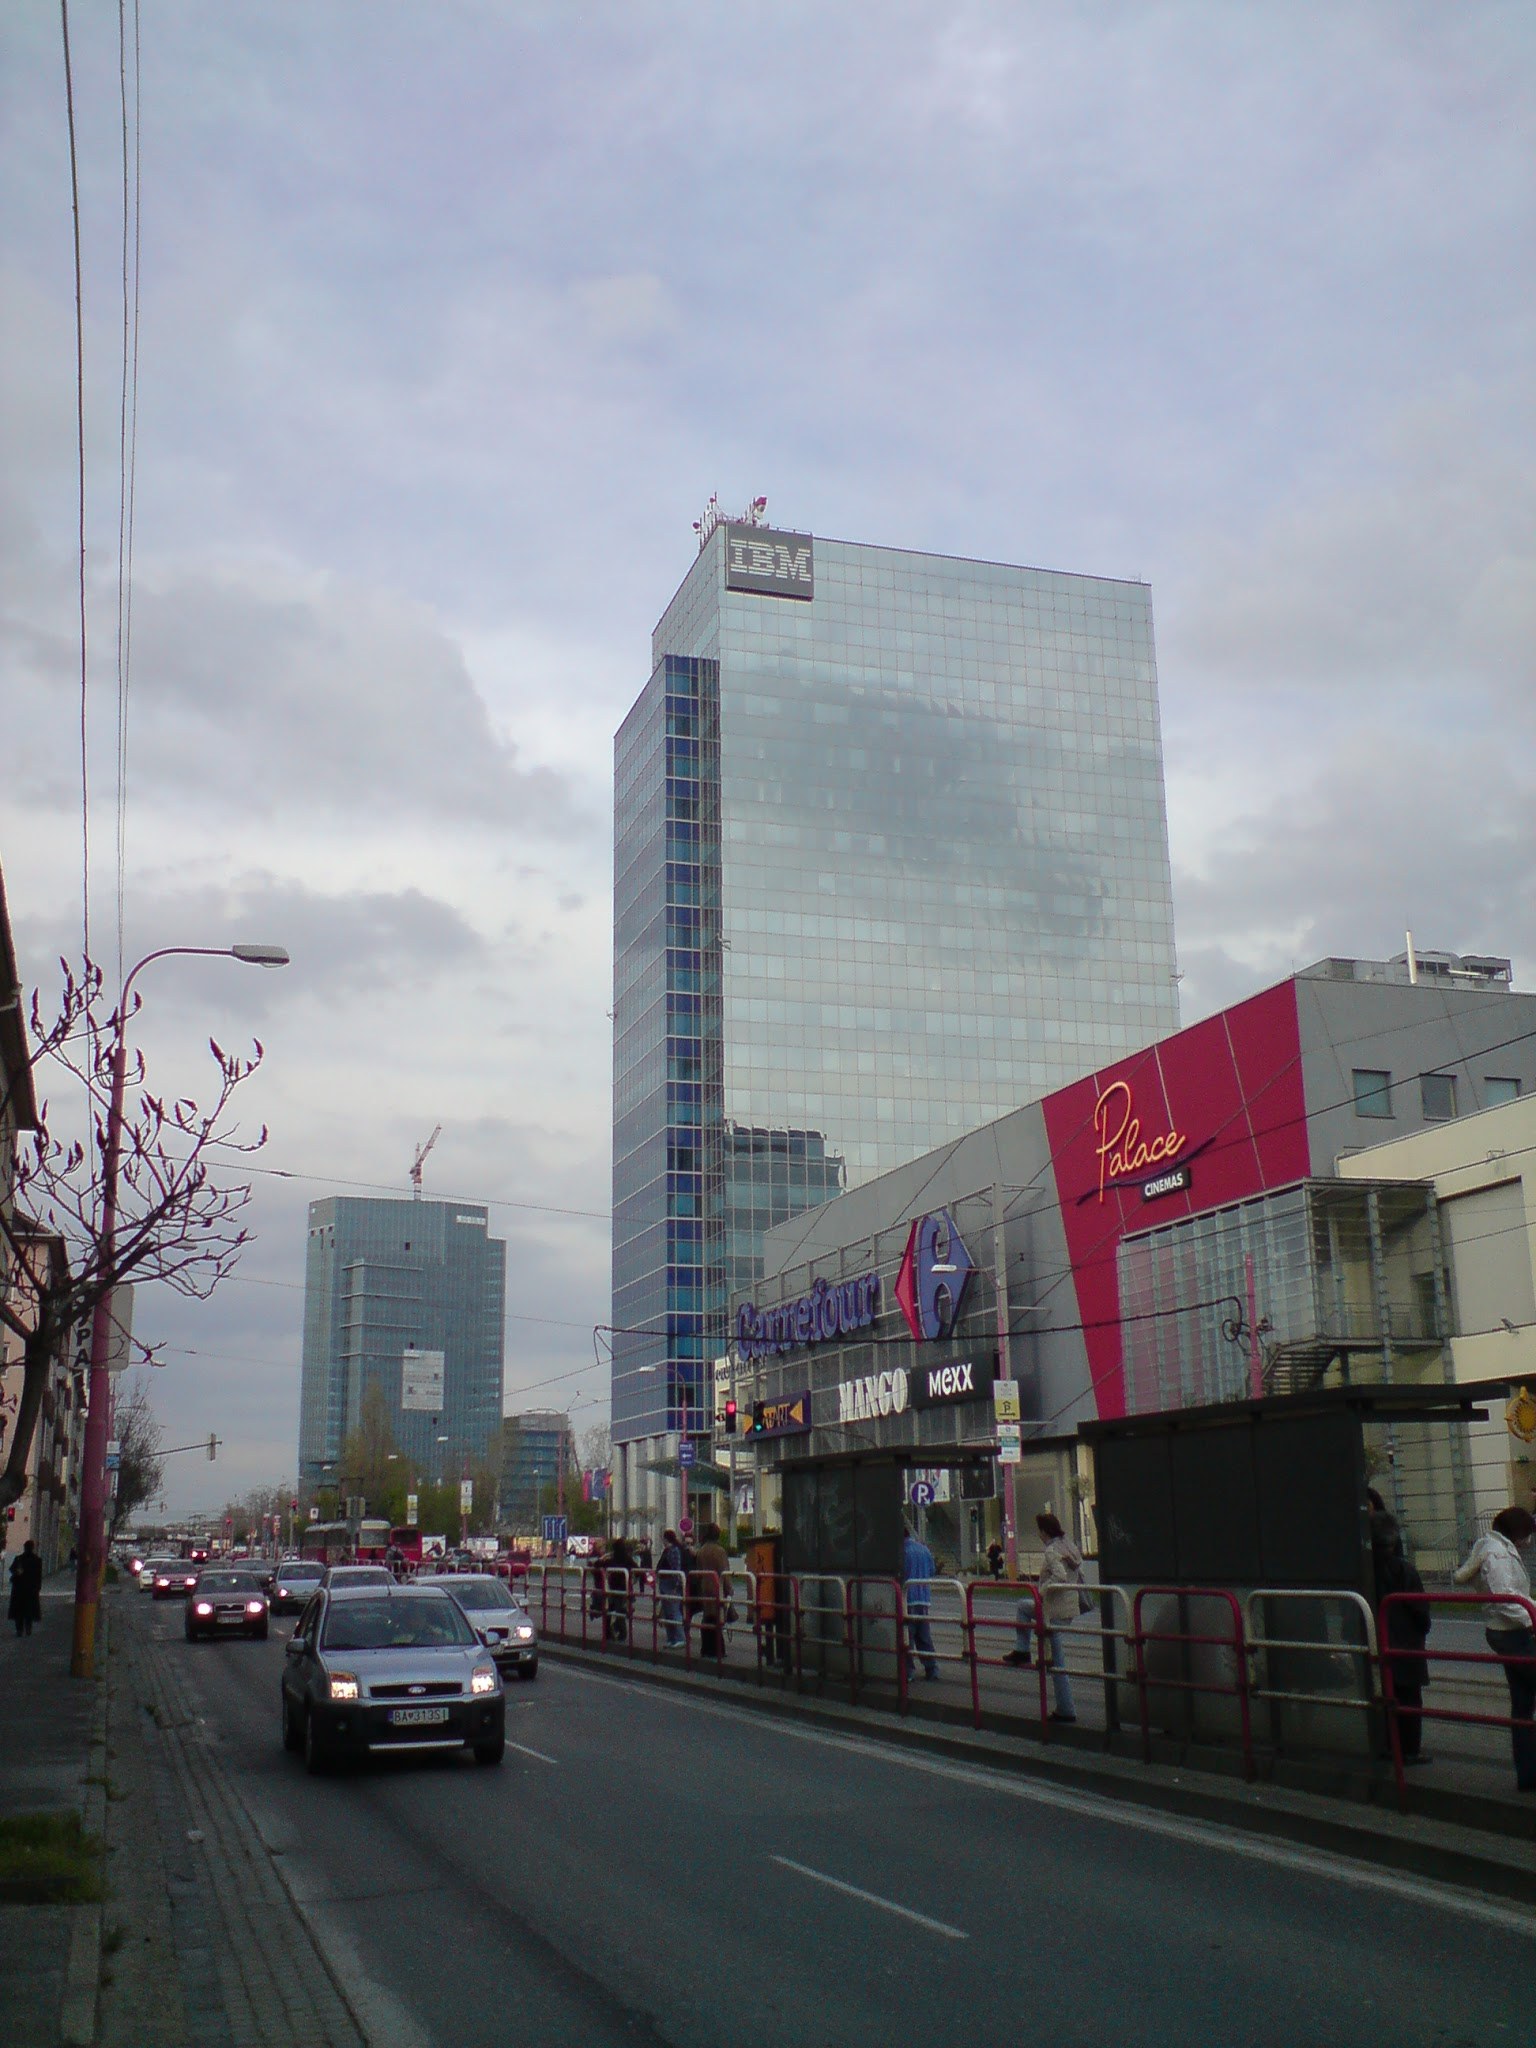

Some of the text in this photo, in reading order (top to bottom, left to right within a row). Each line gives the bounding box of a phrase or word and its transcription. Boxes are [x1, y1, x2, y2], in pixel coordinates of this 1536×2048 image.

[730, 539, 811, 582] IBM
[1094, 1081, 1186, 1202] Palace
[1144, 1172, 1184, 1197] CINEMAS
[737, 1273, 880, 1362] Carrefour
[838, 1367, 908, 1423] MANGO
